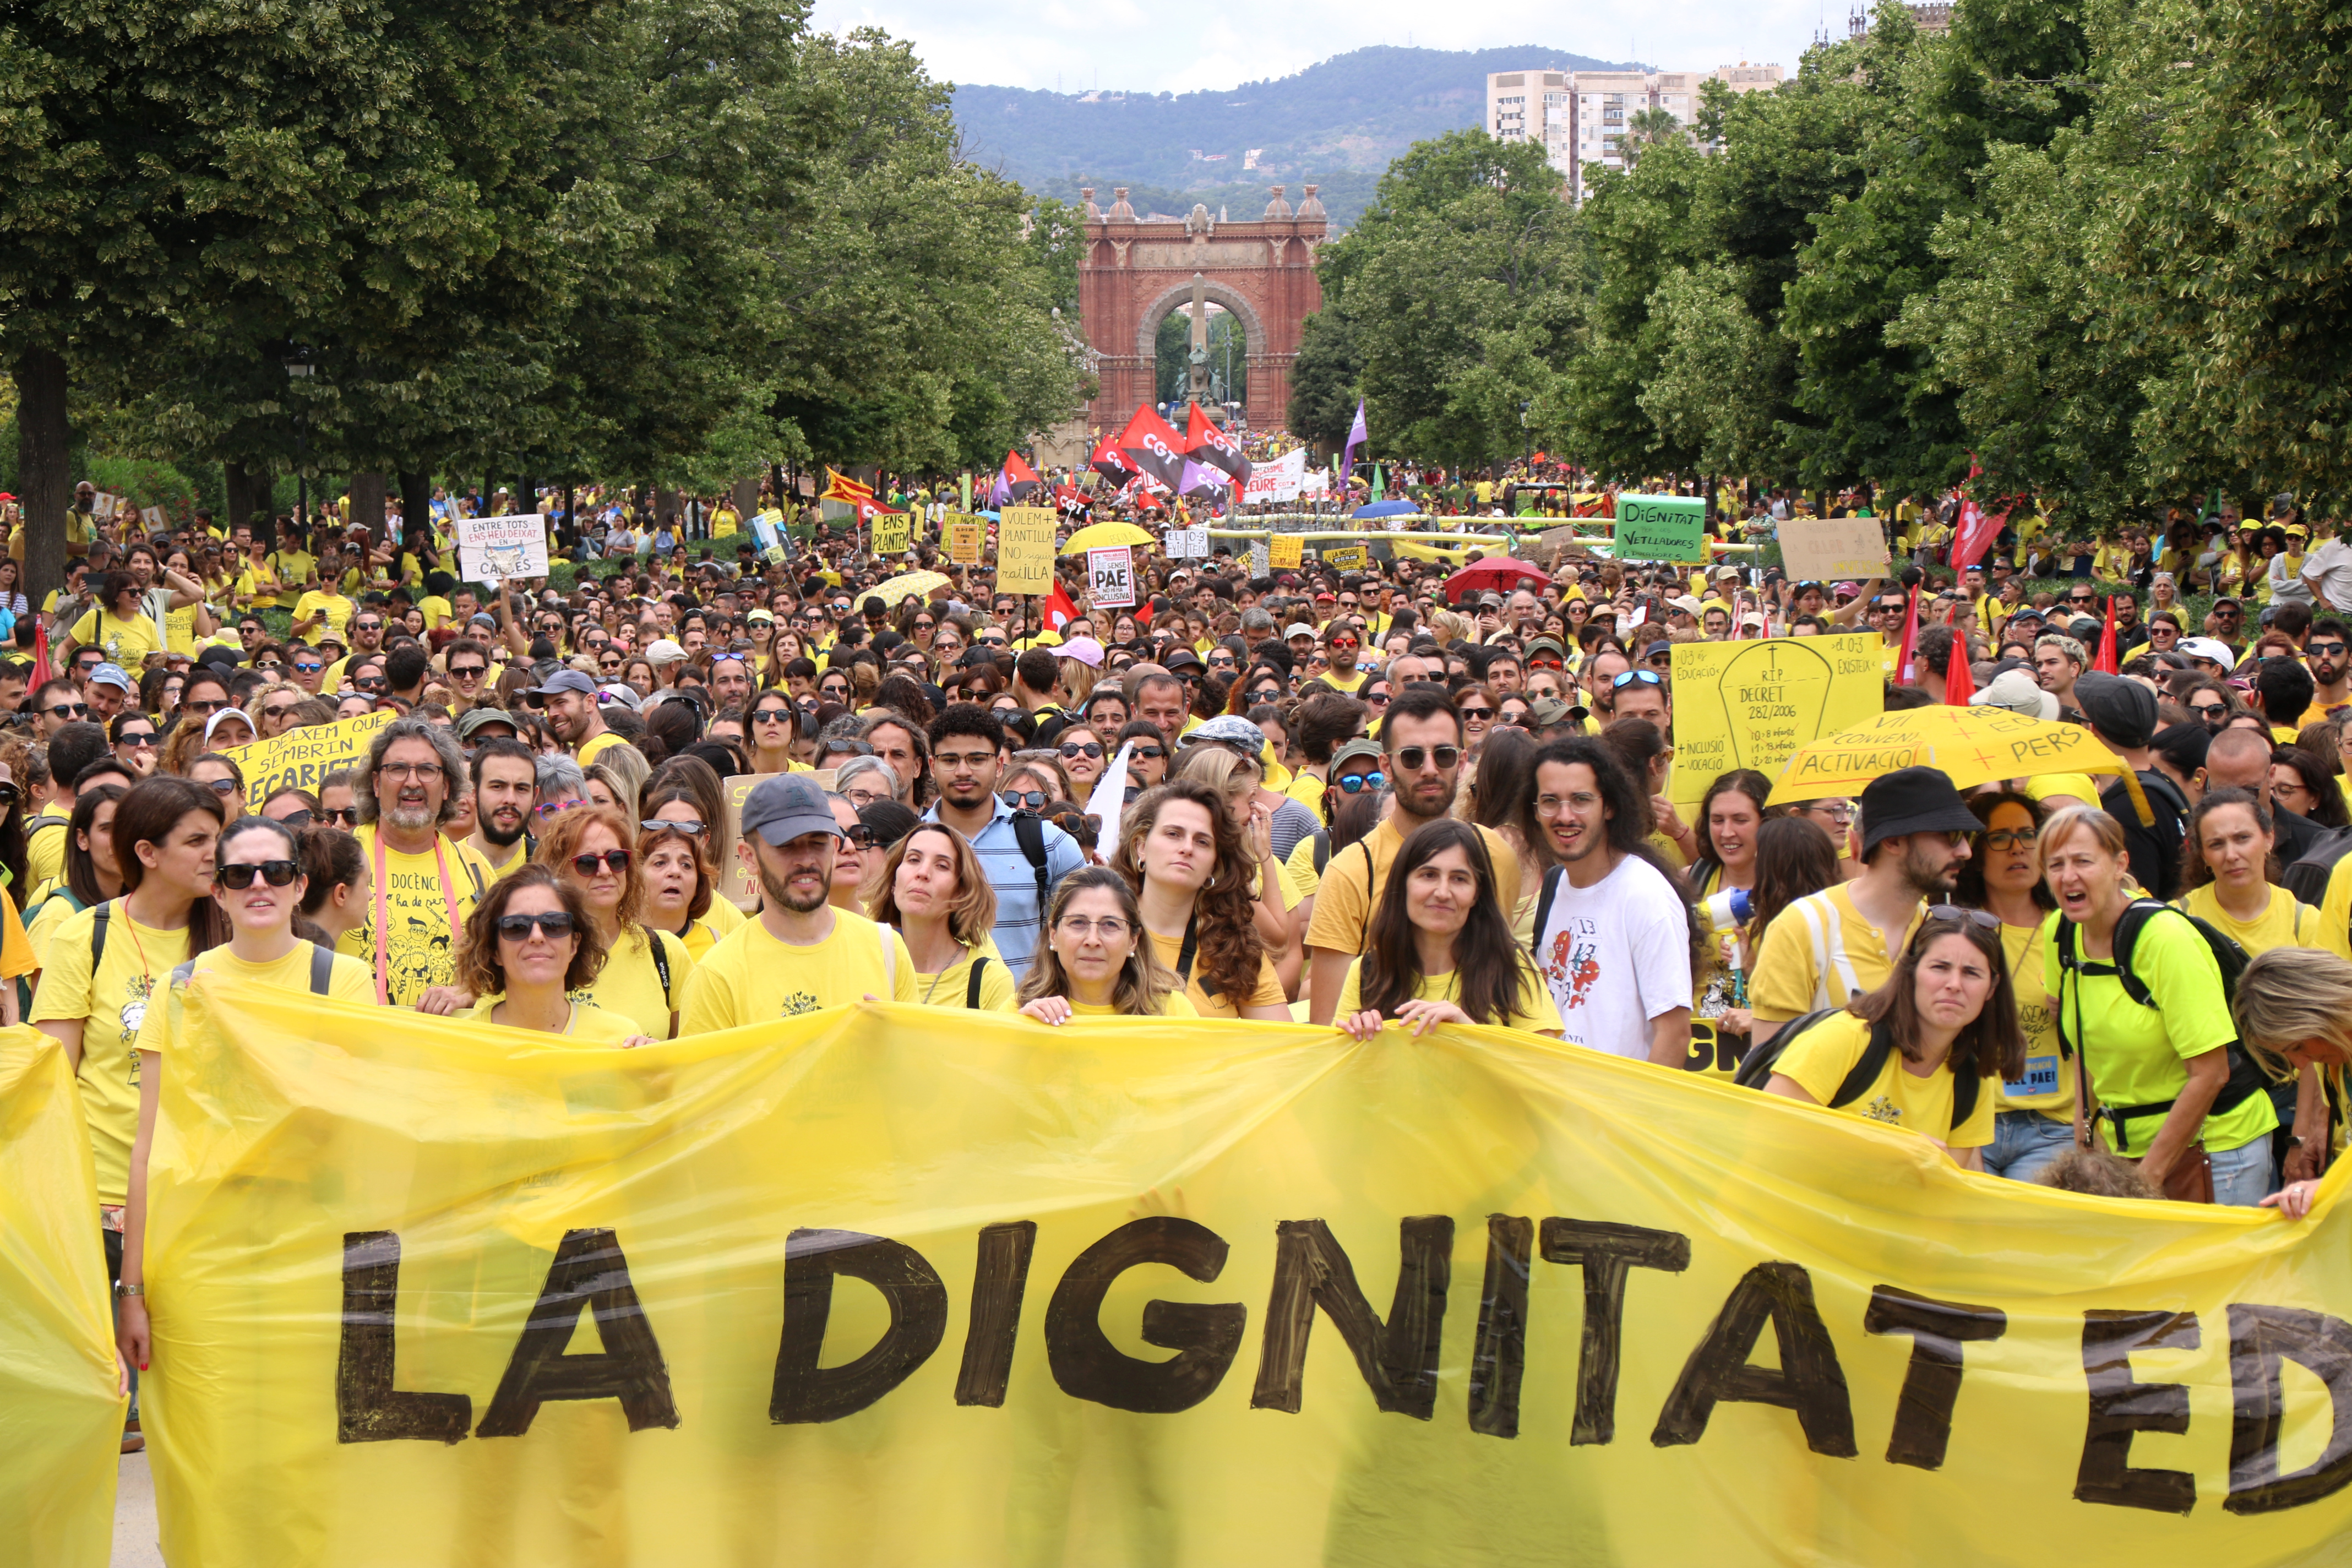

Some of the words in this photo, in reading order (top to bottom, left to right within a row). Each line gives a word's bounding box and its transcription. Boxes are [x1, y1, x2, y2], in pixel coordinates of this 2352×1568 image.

[1143, 433, 1178, 465] CGT
[1204, 429, 1236, 457] CGT
[1197, 473, 1223, 497] CGT
[1059, 495, 1086, 515] CGT
[472, 521, 502, 532] ENTRE
[506, 520, 529, 529] TOTS
[883, 515, 903, 530] ENS
[947, 516, 956, 524] FER
[469, 532, 486, 542] ENS
[488, 530, 506, 540] HEU
[508, 530, 537, 538] DEIXAT
[873, 530, 910, 551] PLANTEM
[1005, 529, 1053, 542] PLANTILLA
[1109, 532, 1137, 544] ESCOLA
[1189, 532, 1205, 542] 0-3
[1624, 531, 1694, 549] VETLLADORES
[1005, 547, 1021, 559] NO
[1023, 553, 1053, 566] siguis
[1624, 549, 1683, 561] EDUCADORES
[480, 559, 531, 574] CAES
[1095, 569, 1128, 589] PAE
[1848, 637, 1863, 653] 0-3
[1739, 685, 1785, 703] DECRET
[1749, 705, 1796, 720] 282/2006
[268, 725, 339, 754] DEIXEM
[352, 714, 387, 732] QUE
[1773, 728, 1795, 737] infants
[1834, 732, 1920, 745] CONVENI
[1774, 741, 1796, 750] infants
[2011, 725, 2082, 763] PERS
[258, 738, 353, 774] SEMBRIN
[1687, 754, 1725, 770] VOCACIÓ
[396, 894, 409, 907] ha
[413, 895, 422, 907] de
[659, 962, 668, 987] Quechua
[2031, 1071, 2056, 1085] PAE!
[335, 1227, 682, 1447] LA
[769, 1216, 2007, 1471] DIGNITAT
[2073, 1303, 2352, 1517] ED
